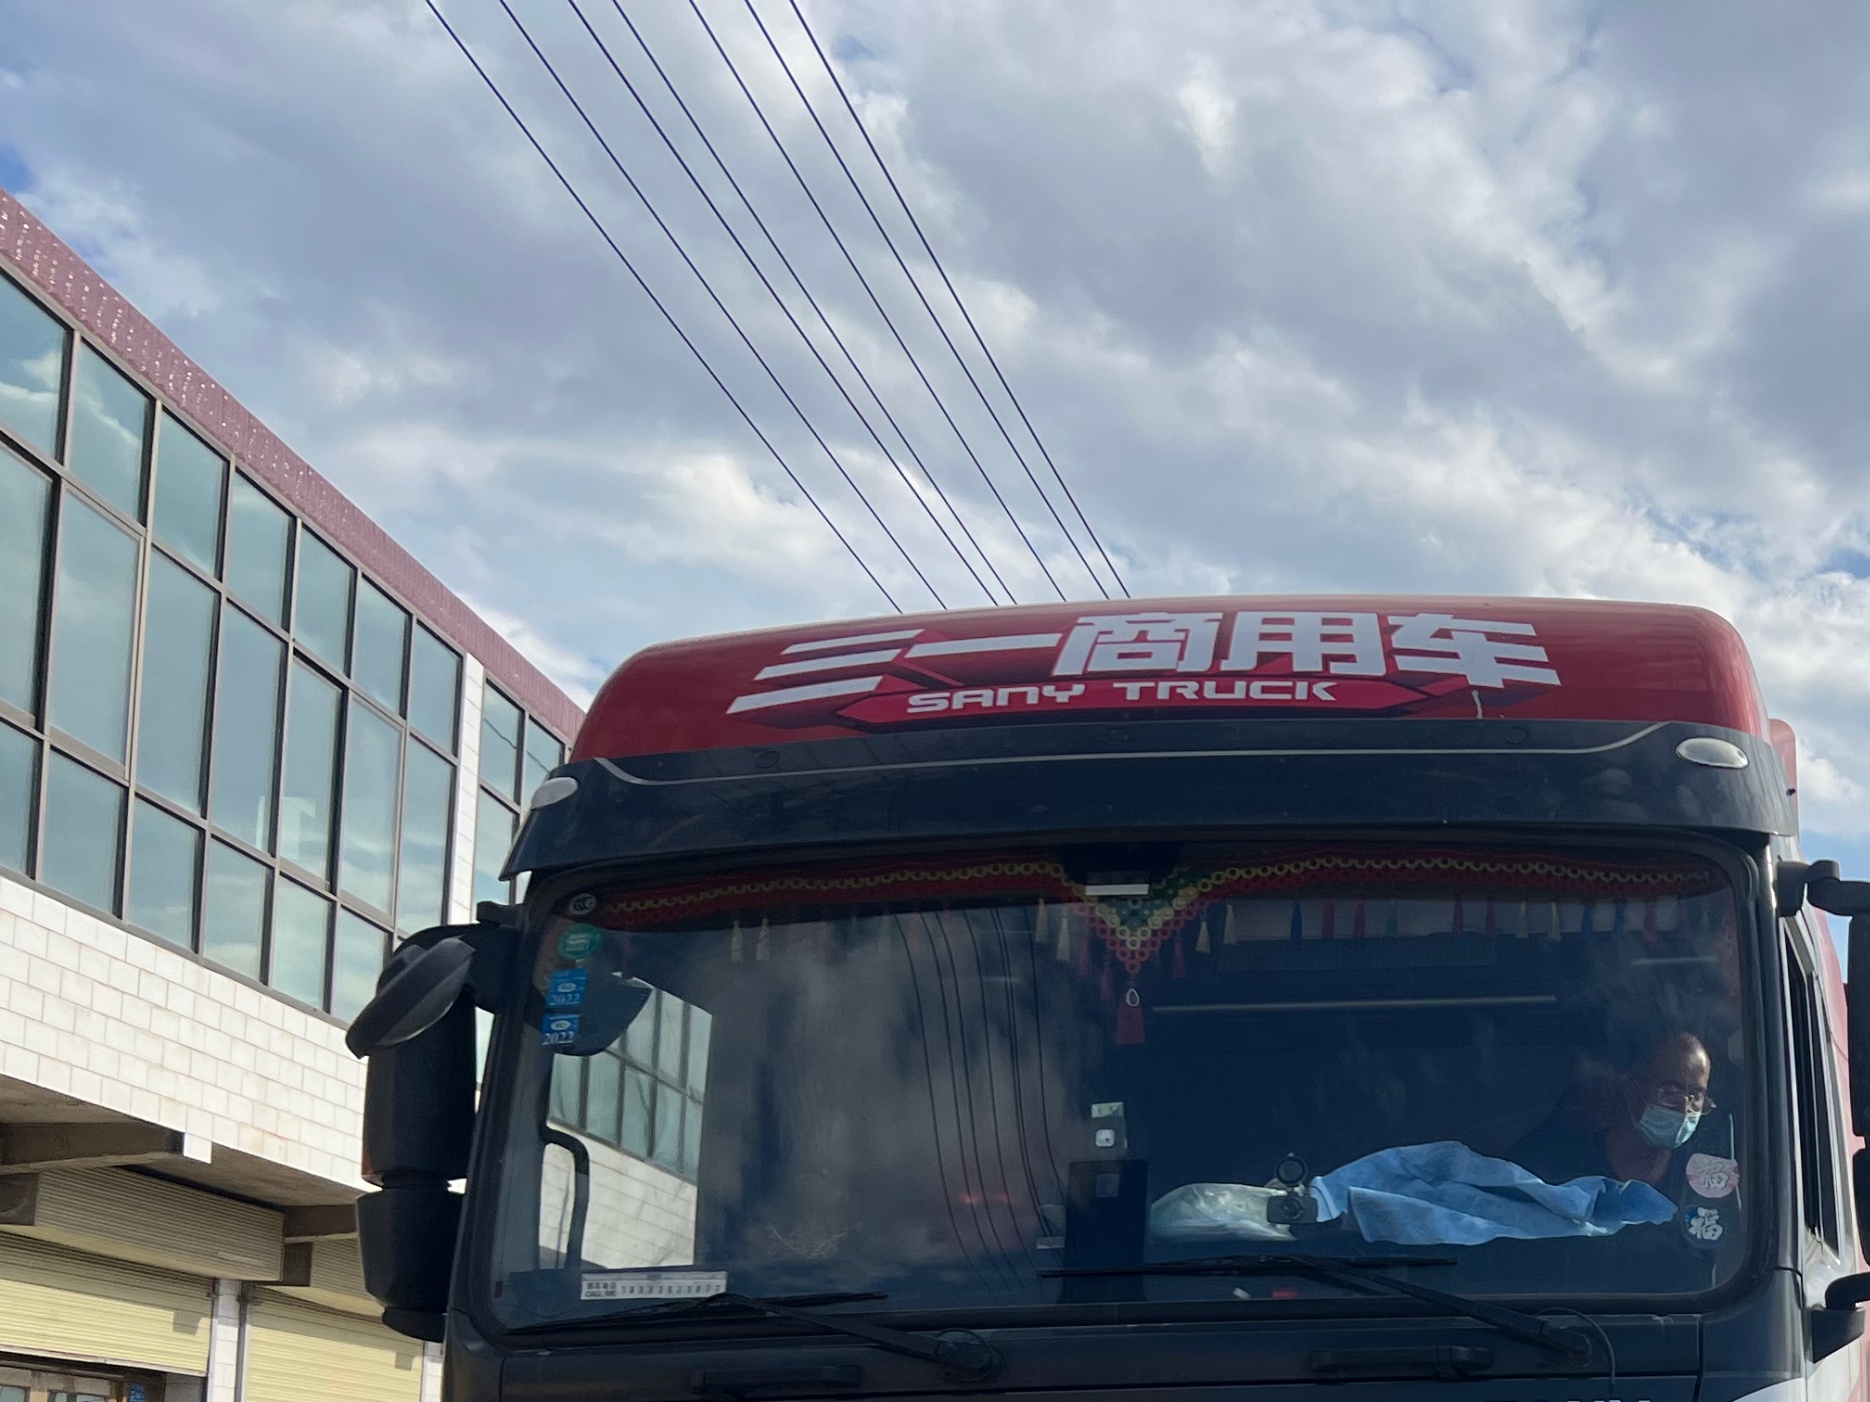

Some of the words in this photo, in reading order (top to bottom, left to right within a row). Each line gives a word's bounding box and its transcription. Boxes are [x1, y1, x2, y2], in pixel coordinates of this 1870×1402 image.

[727, 611, 1563, 714] 三一商用车
[907, 683, 1085, 713] SANY
[1113, 680, 1337, 702] TRUCK
[1689, 1207, 1723, 1240] 福
